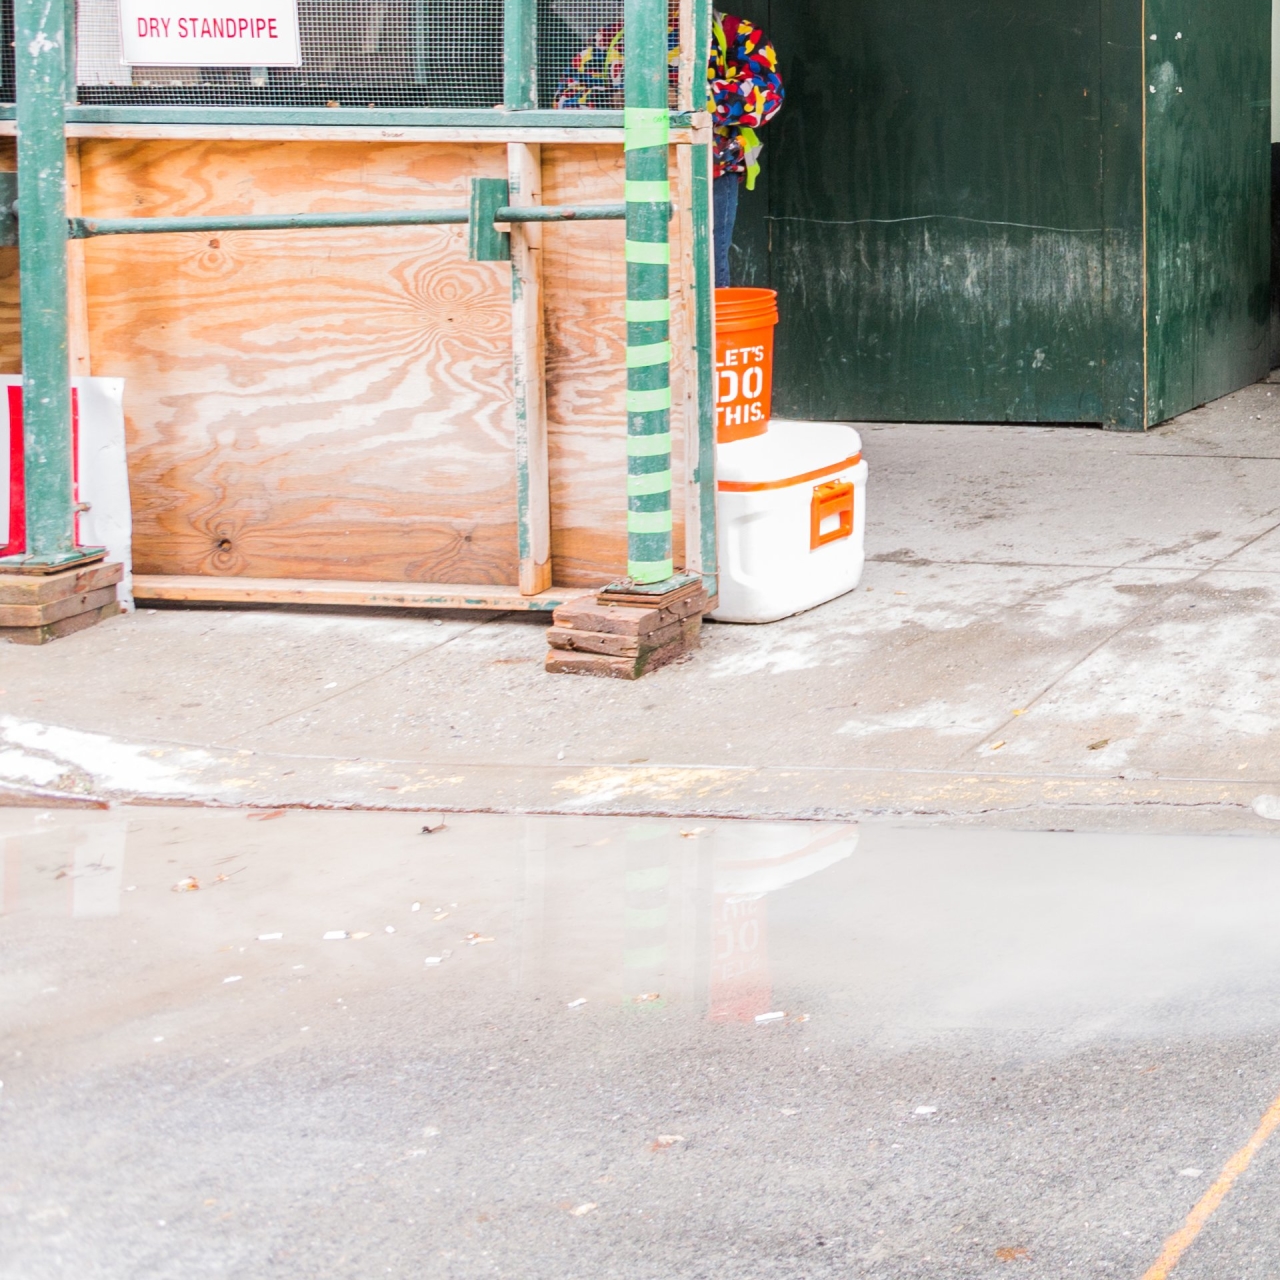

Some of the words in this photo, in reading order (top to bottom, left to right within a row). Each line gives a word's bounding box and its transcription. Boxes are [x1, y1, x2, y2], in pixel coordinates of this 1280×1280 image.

[137, 17, 170, 39] DRY
[178, 17, 279, 39] STANDPIPE
[716, 366, 763, 404] DO
